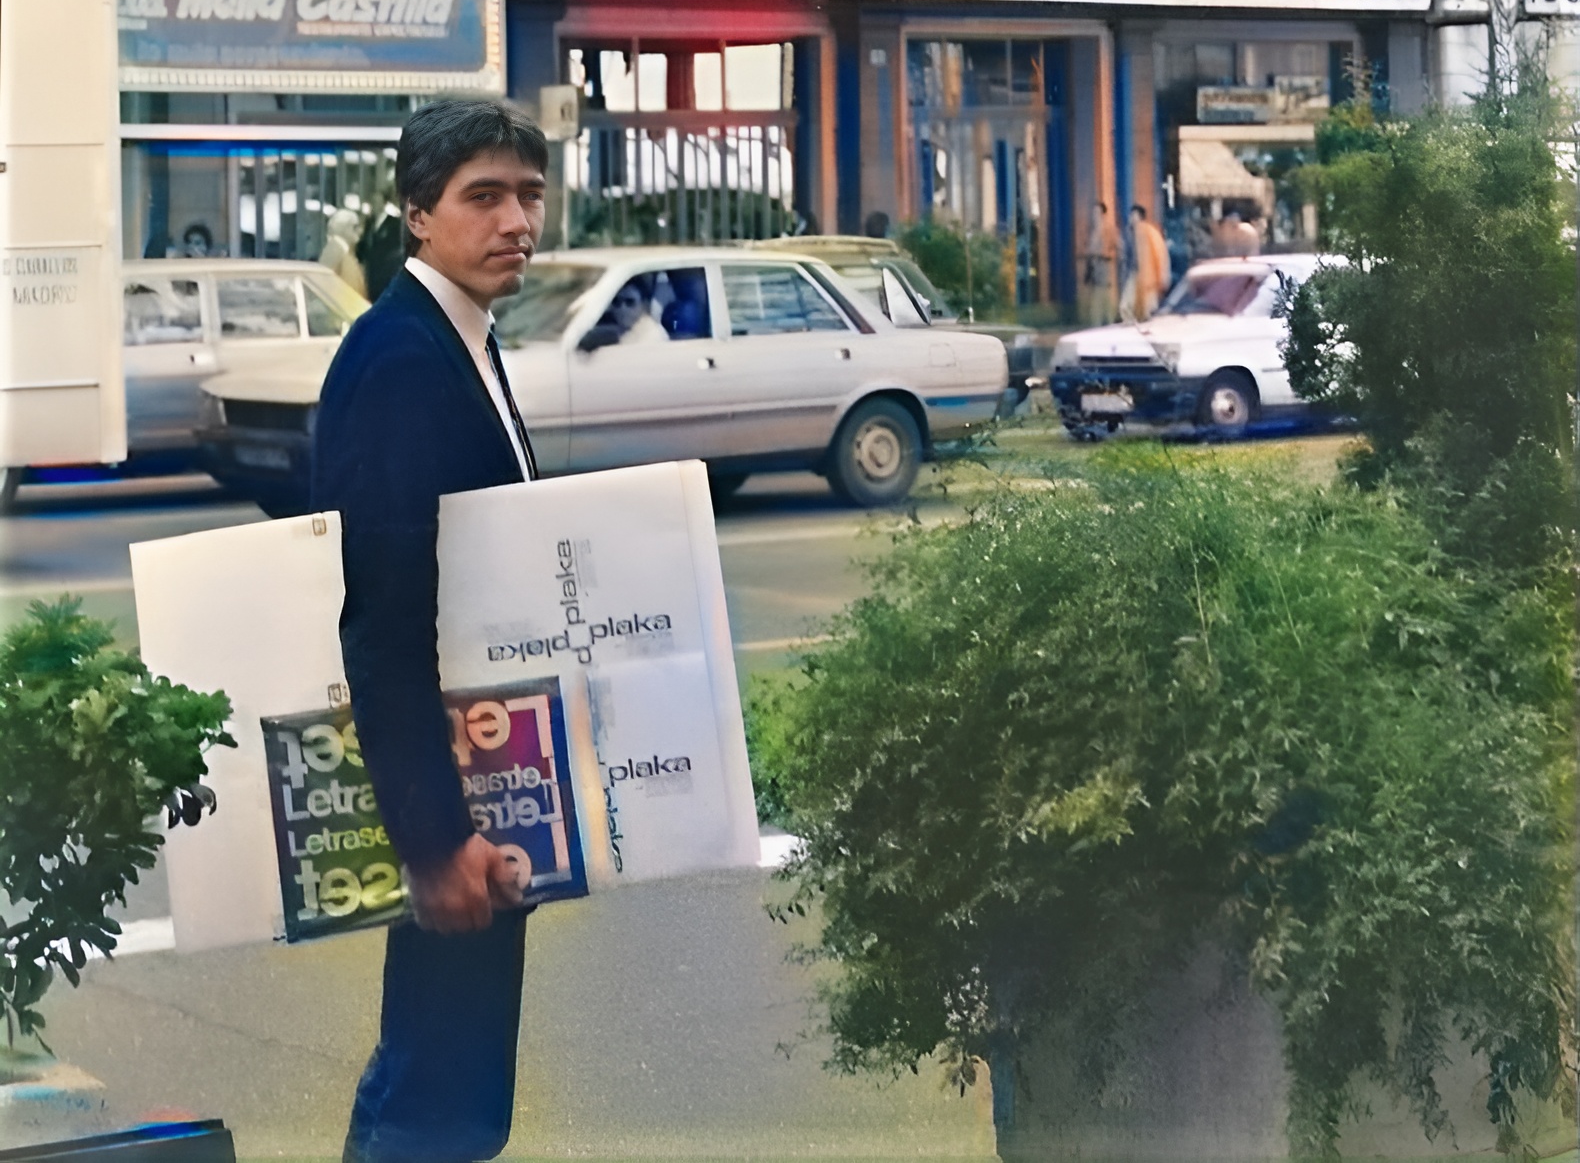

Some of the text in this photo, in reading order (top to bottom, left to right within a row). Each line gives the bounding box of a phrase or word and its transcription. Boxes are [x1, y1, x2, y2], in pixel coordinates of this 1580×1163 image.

[556, 539, 586, 625] plaka
[589, 613, 672, 645] plaka
[608, 754, 692, 788] plaka
[282, 779, 378, 822] Letra
[287, 825, 391, 858] Letrase
